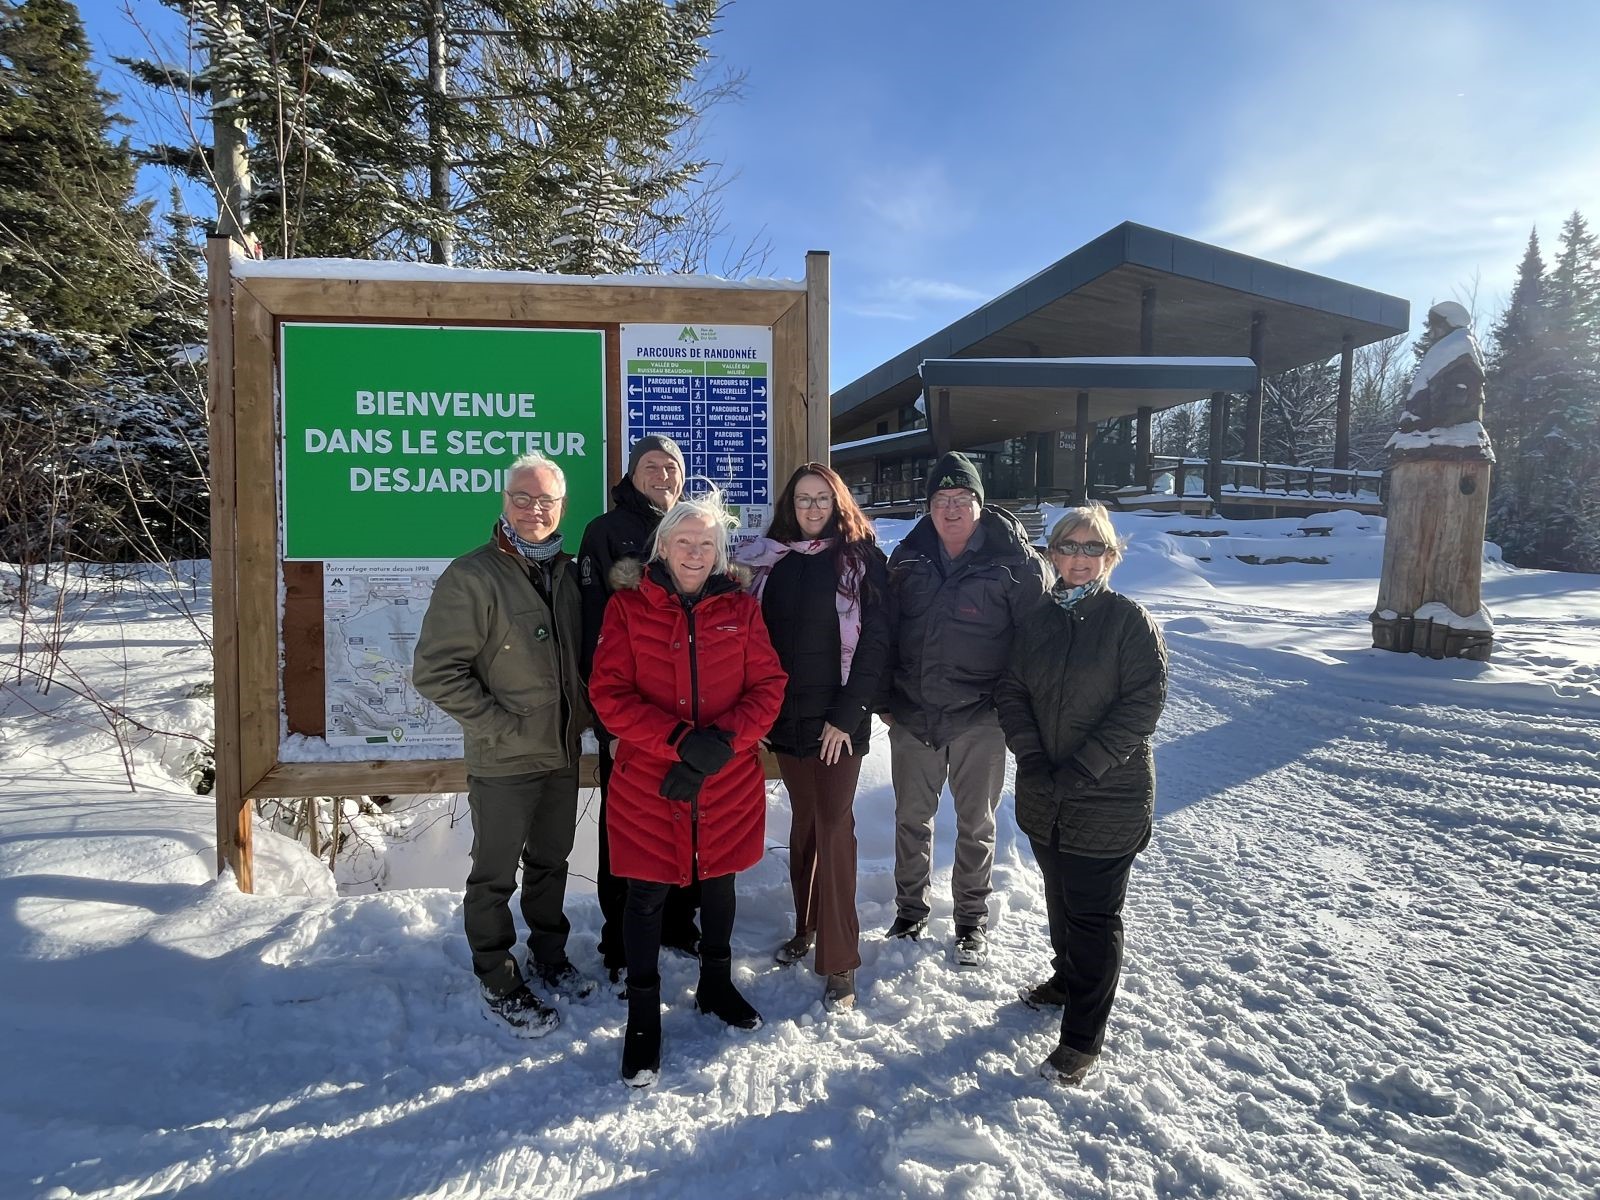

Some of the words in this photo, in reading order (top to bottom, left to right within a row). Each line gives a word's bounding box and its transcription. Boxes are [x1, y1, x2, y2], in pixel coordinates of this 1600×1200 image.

[637, 347, 687, 358] PARCOURS
[690, 348, 701, 358] DE
[704, 346, 757, 360] RANDONNÉE
[652, 386, 671, 394] VIEILLE
[672, 385, 688, 394] FORÊT
[712, 387, 747, 395] PASSERELLES
[355, 390, 536, 418] BIENVENUE
[649, 413, 661, 421] DES
[661, 413, 685, 421] RAVAGES
[724, 414, 751, 422] CHOCOLAT
[305, 428, 393, 454] DANS
[402, 430, 438, 455] LE
[446, 430, 586, 457] SECTEUR
[326, 562, 344, 572] Votre
[392, 565, 414, 573] depuis
